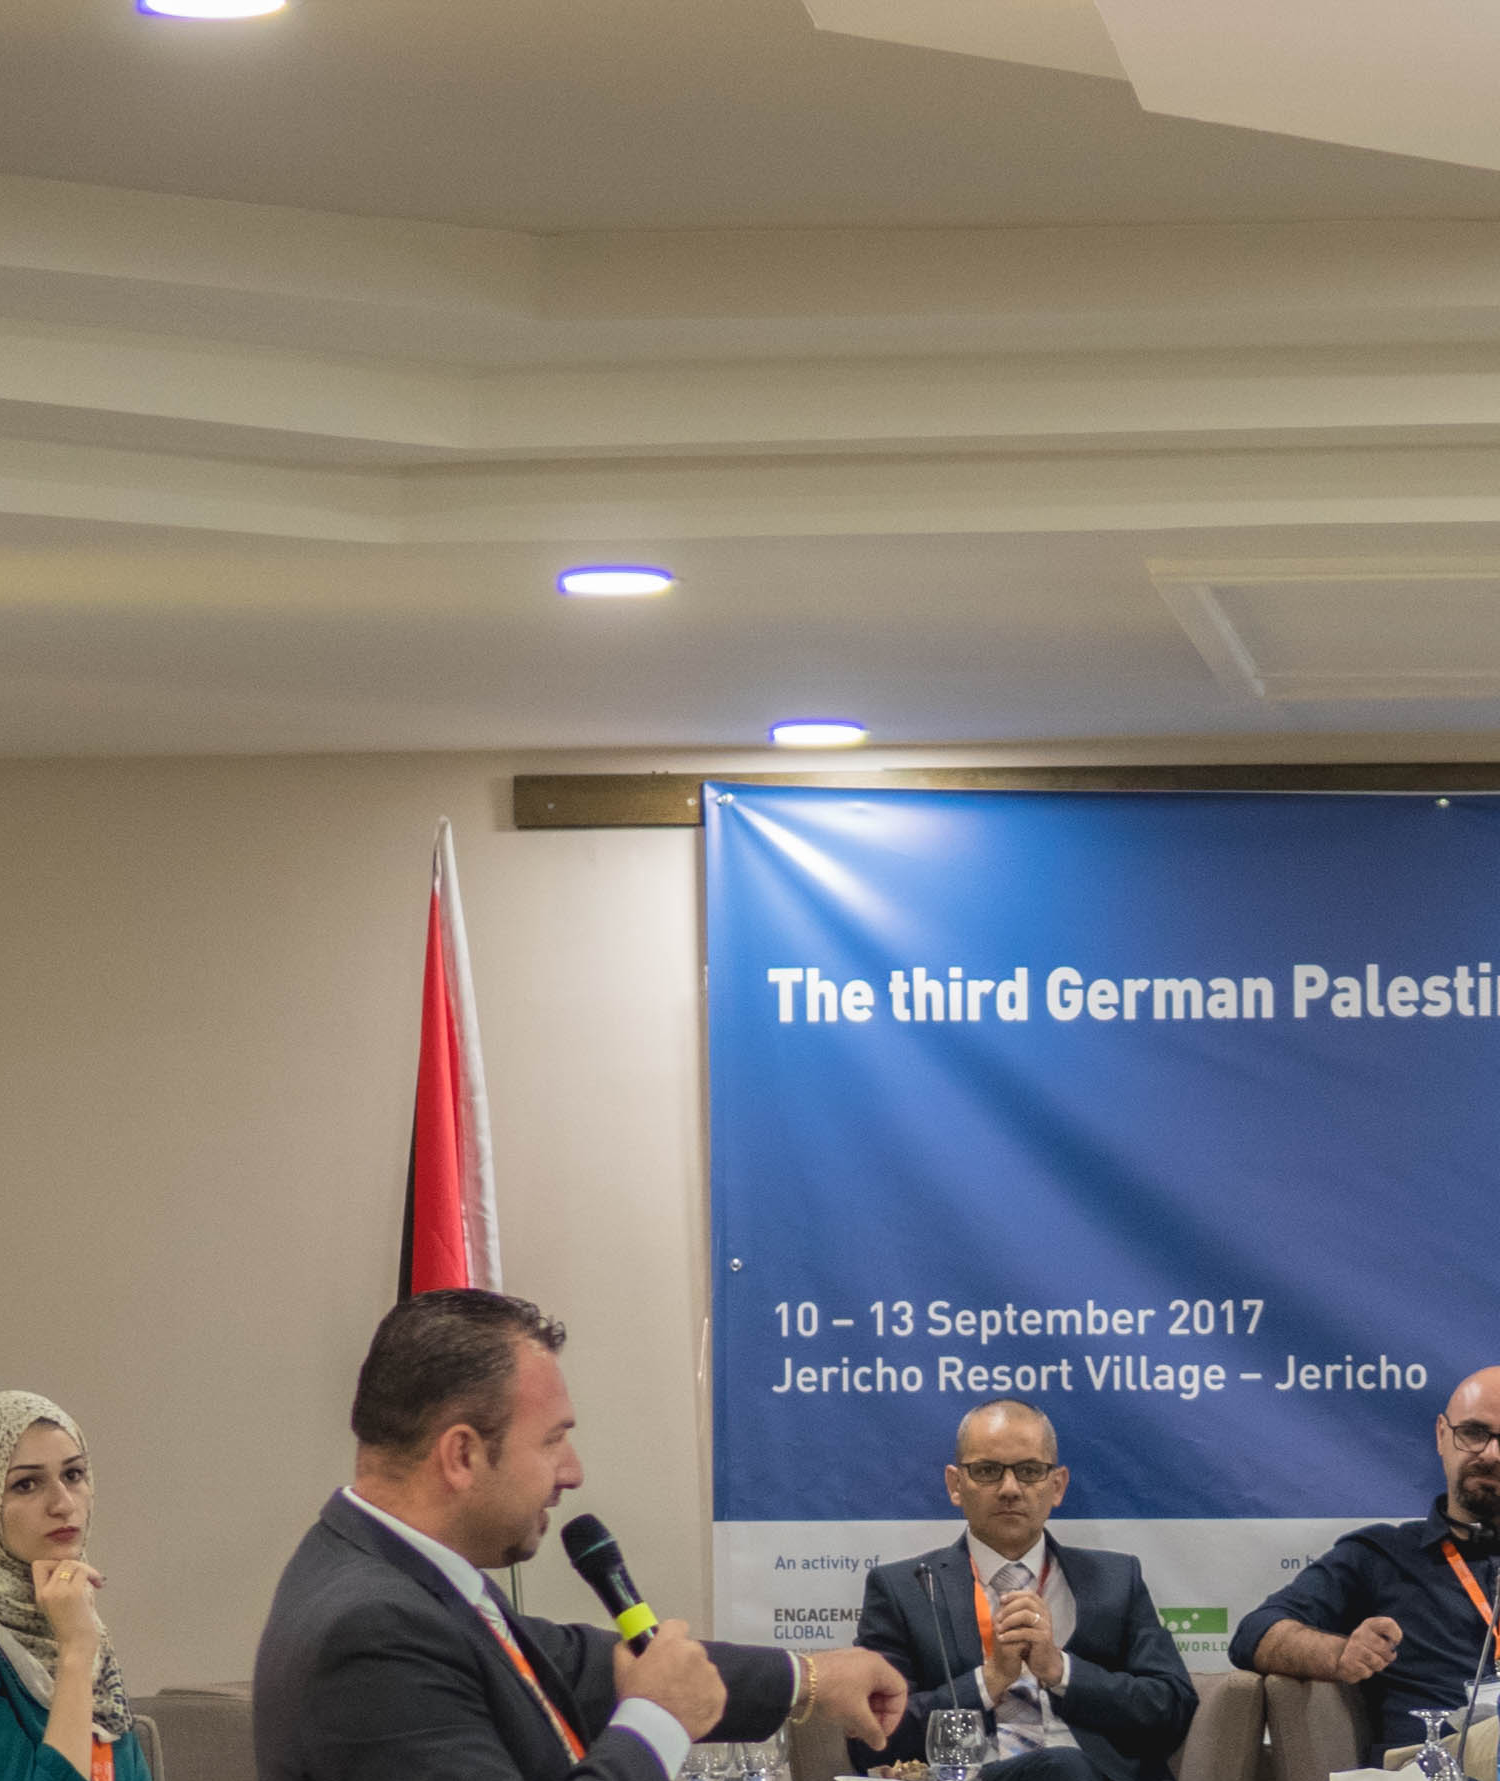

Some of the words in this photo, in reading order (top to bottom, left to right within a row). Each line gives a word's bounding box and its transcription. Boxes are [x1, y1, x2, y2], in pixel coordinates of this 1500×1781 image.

[767, 967, 875, 1024] The
[888, 966, 1029, 1022] third
[1046, 966, 1274, 1022] German
[775, 1301, 819, 1337] 10
[870, 1300, 914, 1337] 13
[927, 1299, 1156, 1345] September
[1168, 1299, 1264, 1336] 2017
[771, 1357, 923, 1393] Jericho
[938, 1356, 1073, 1392] Resort
[1084, 1355, 1227, 1401] Village
[1275, 1354, 1427, 1391] Jericho
[774, 1555, 796, 1571] An
[801, 1554, 863, 1573] activity
[866, 1554, 880, 1571] of
[1280, 1558, 1301, 1570] on
[774, 1607, 862, 1623] ENGAGEME
[774, 1625, 835, 1640] GLOBAL
[1176, 1641, 1228, 1652] WORLD
